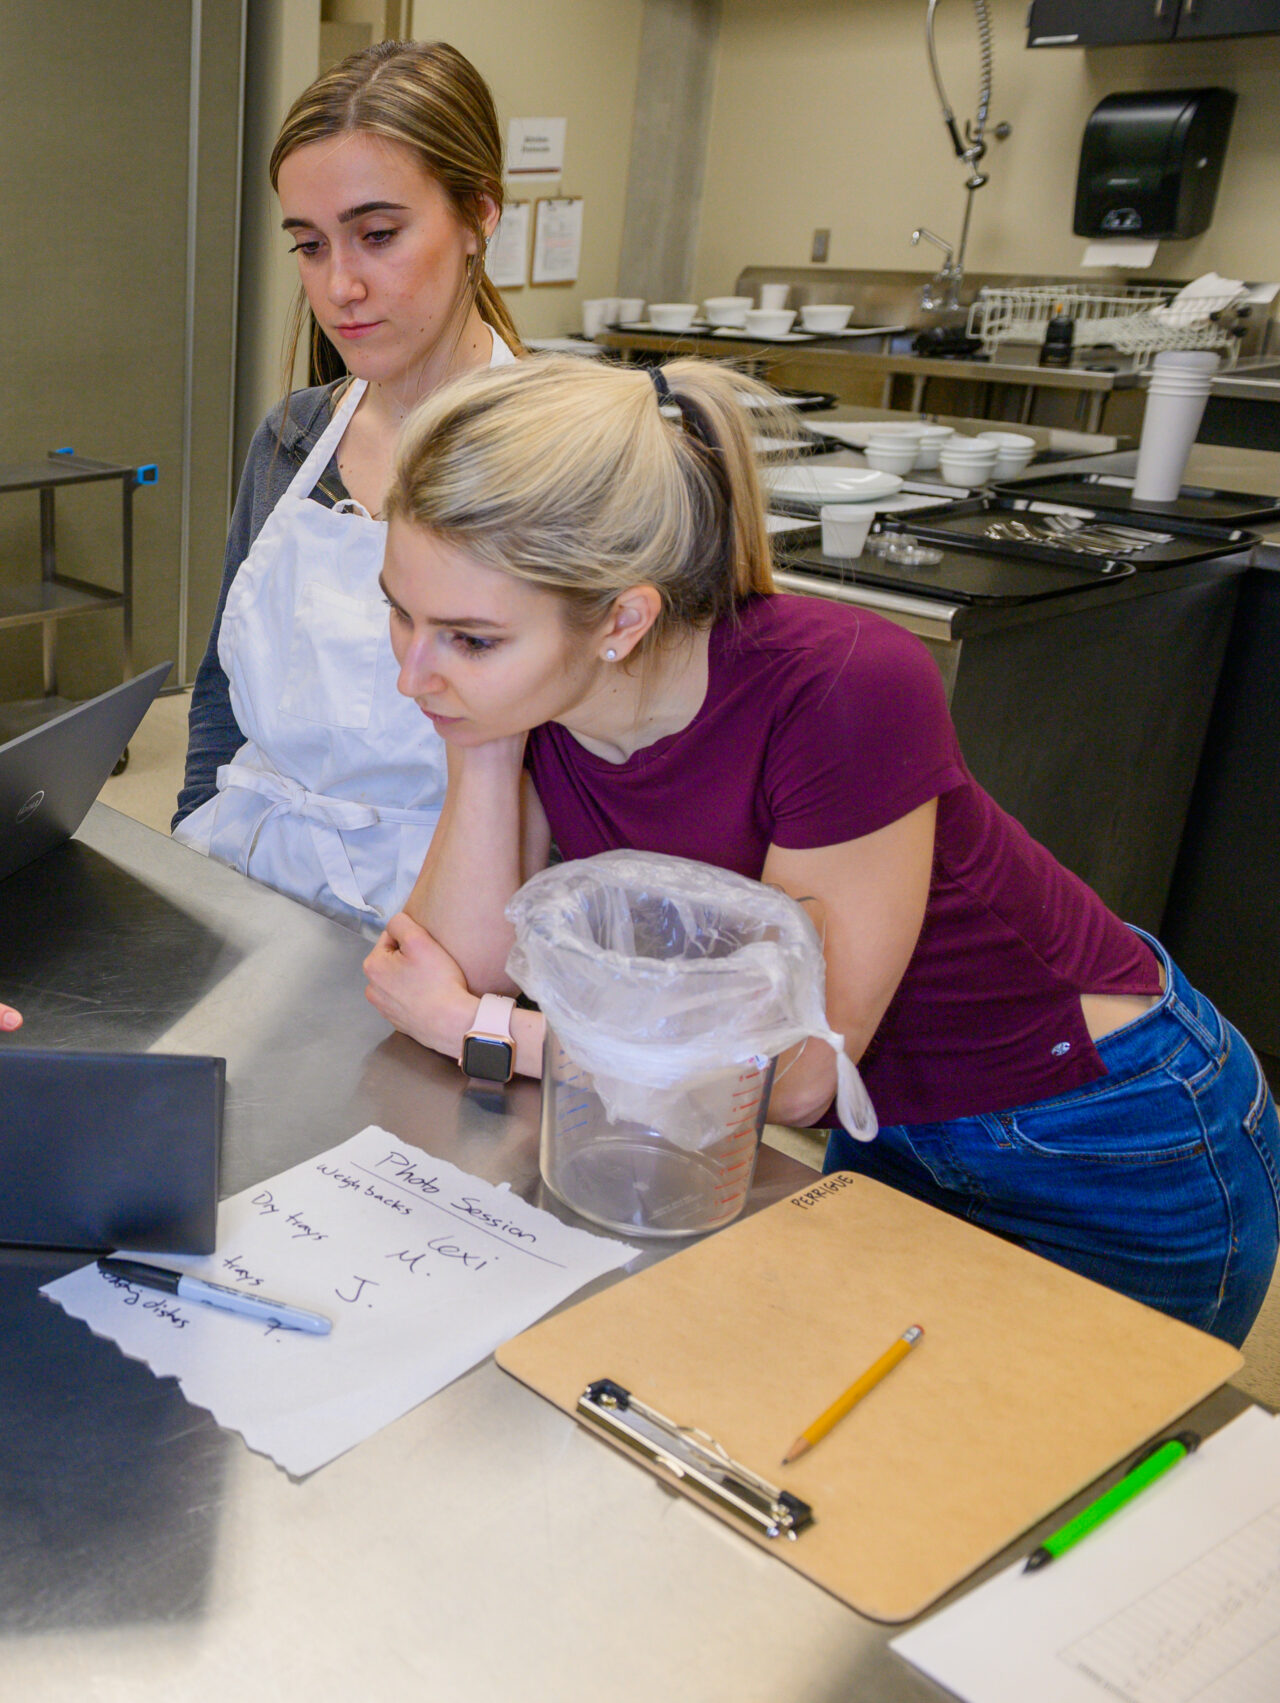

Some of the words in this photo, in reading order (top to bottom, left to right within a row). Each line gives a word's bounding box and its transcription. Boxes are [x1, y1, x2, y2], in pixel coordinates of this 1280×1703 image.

[364, 1185, 413, 1216] backs
[374, 1151, 440, 1194] Photo
[450, 1197, 537, 1243] Session
[791, 1174, 854, 1210] PERRIGUE
[285, 1211, 329, 1241] trays
[222, 1255, 265, 1287] trays
[142, 1299, 190, 1329] dishes
